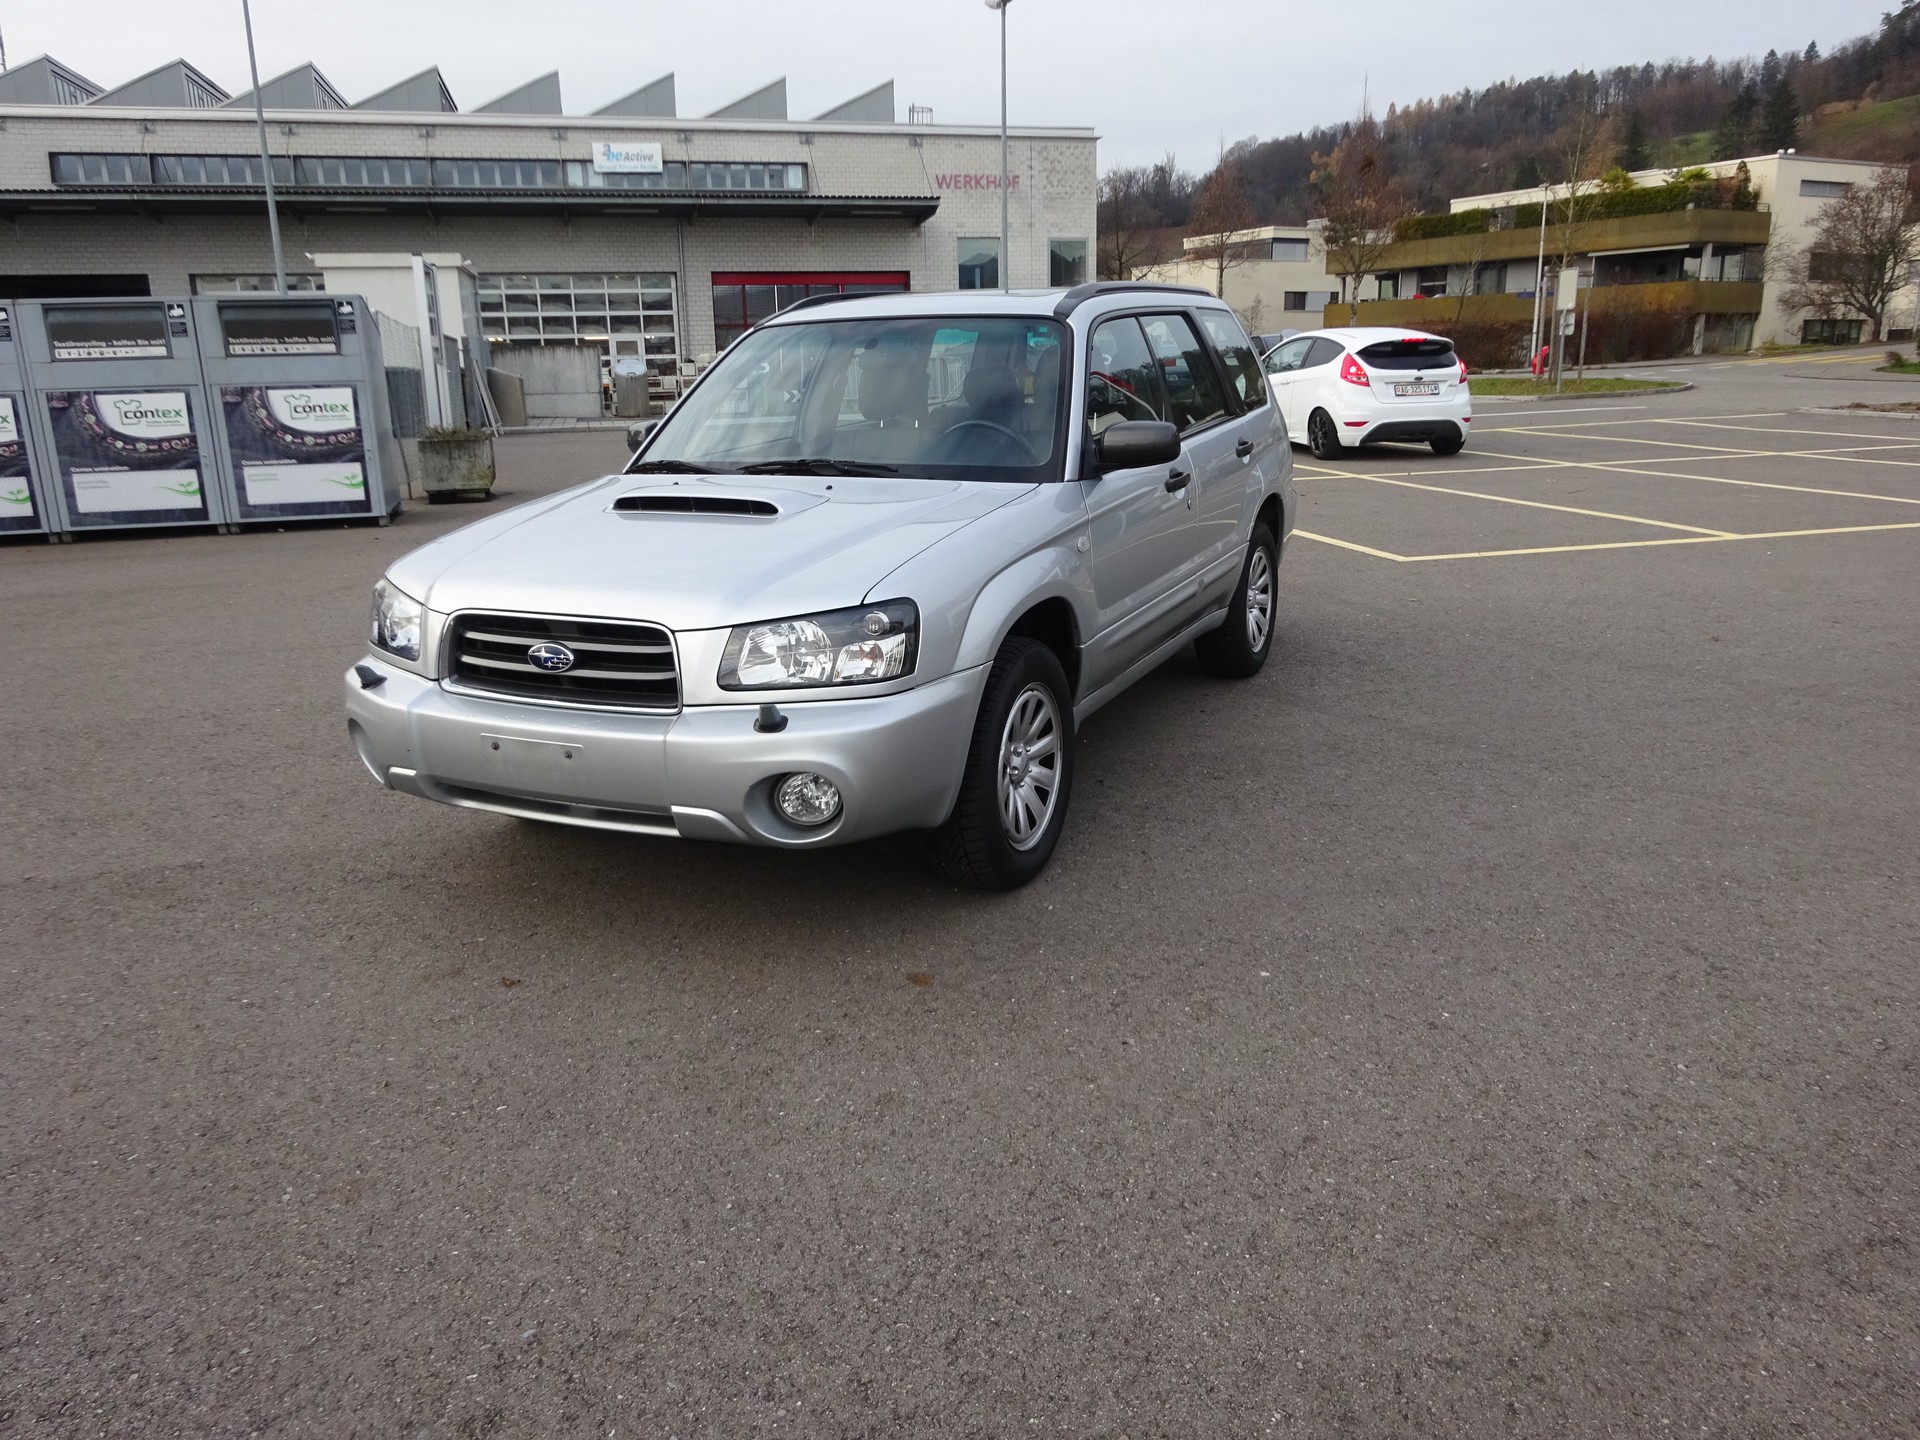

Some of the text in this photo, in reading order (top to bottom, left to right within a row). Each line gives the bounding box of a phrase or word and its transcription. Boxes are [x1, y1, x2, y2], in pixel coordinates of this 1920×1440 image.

[624, 149, 654, 161] Active
[936, 174, 1020, 190] WERKHOF
[53, 340, 107, 348] Textilrecycling
[228, 336, 279, 344] Textilrecycling
[124, 407, 184, 420] contex
[293, 402, 350, 415] contex
